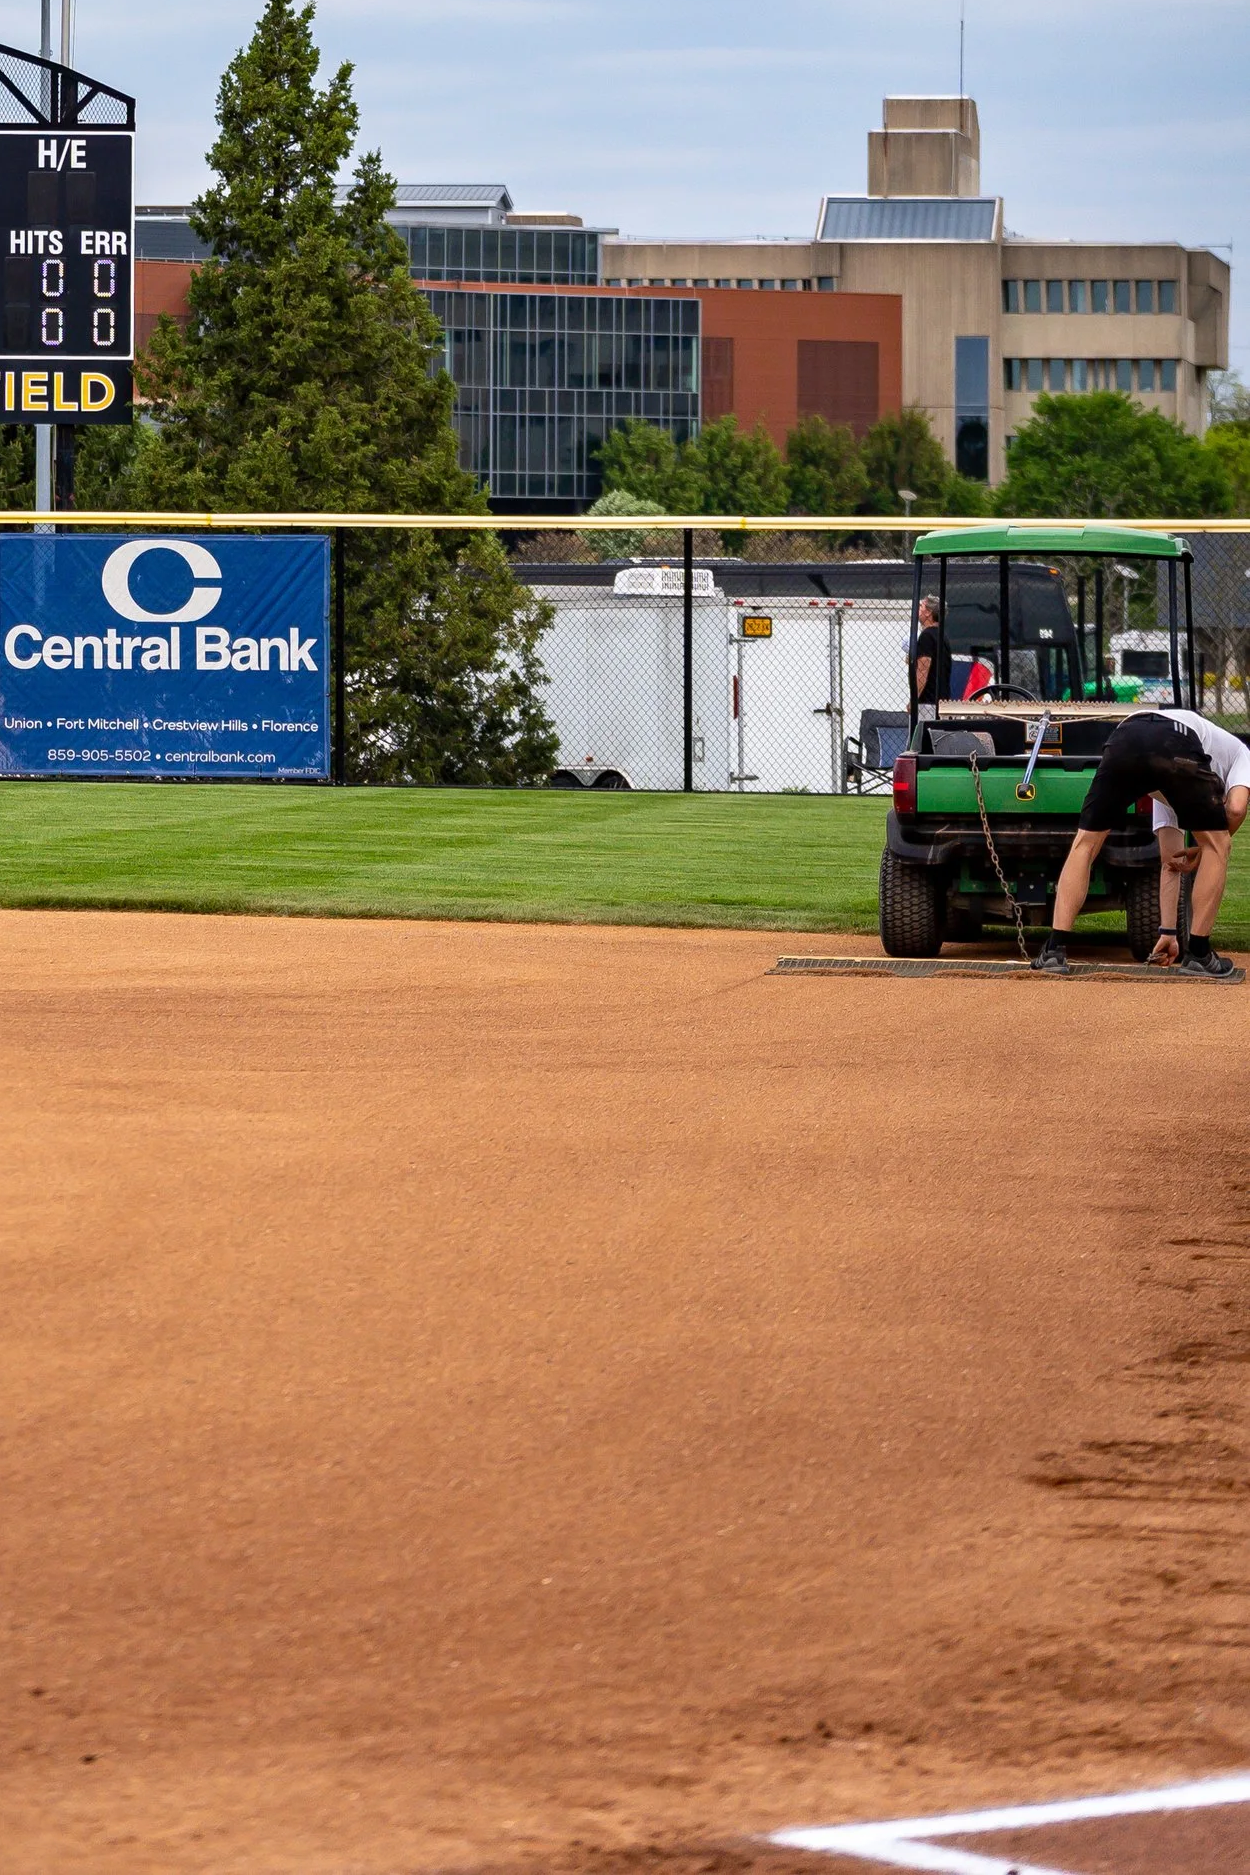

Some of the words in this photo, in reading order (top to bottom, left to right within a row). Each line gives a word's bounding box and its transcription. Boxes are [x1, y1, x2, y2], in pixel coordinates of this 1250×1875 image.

[38, 139, 86, 169] H/E
[11, 230, 63, 255] HITS
[81, 231, 127, 255] ERR
[42, 259, 64, 298] 0
[93, 259, 115, 298] 0
[41, 307, 64, 346] 0
[93, 307, 114, 346] 0
[4, 623, 180, 671] Central
[196, 627, 318, 672] Bank
[5, 717, 43, 729] Union
[57, 718, 85, 729] Fort
[88, 718, 139, 730] Mitchell
[153, 719, 219, 732] Crestview
[222, 719, 248, 732] Hills
[262, 720, 319, 732] Florence
[48, 749, 151, 762] 859-905-5502
[165, 750, 276, 763] centralbank.com
